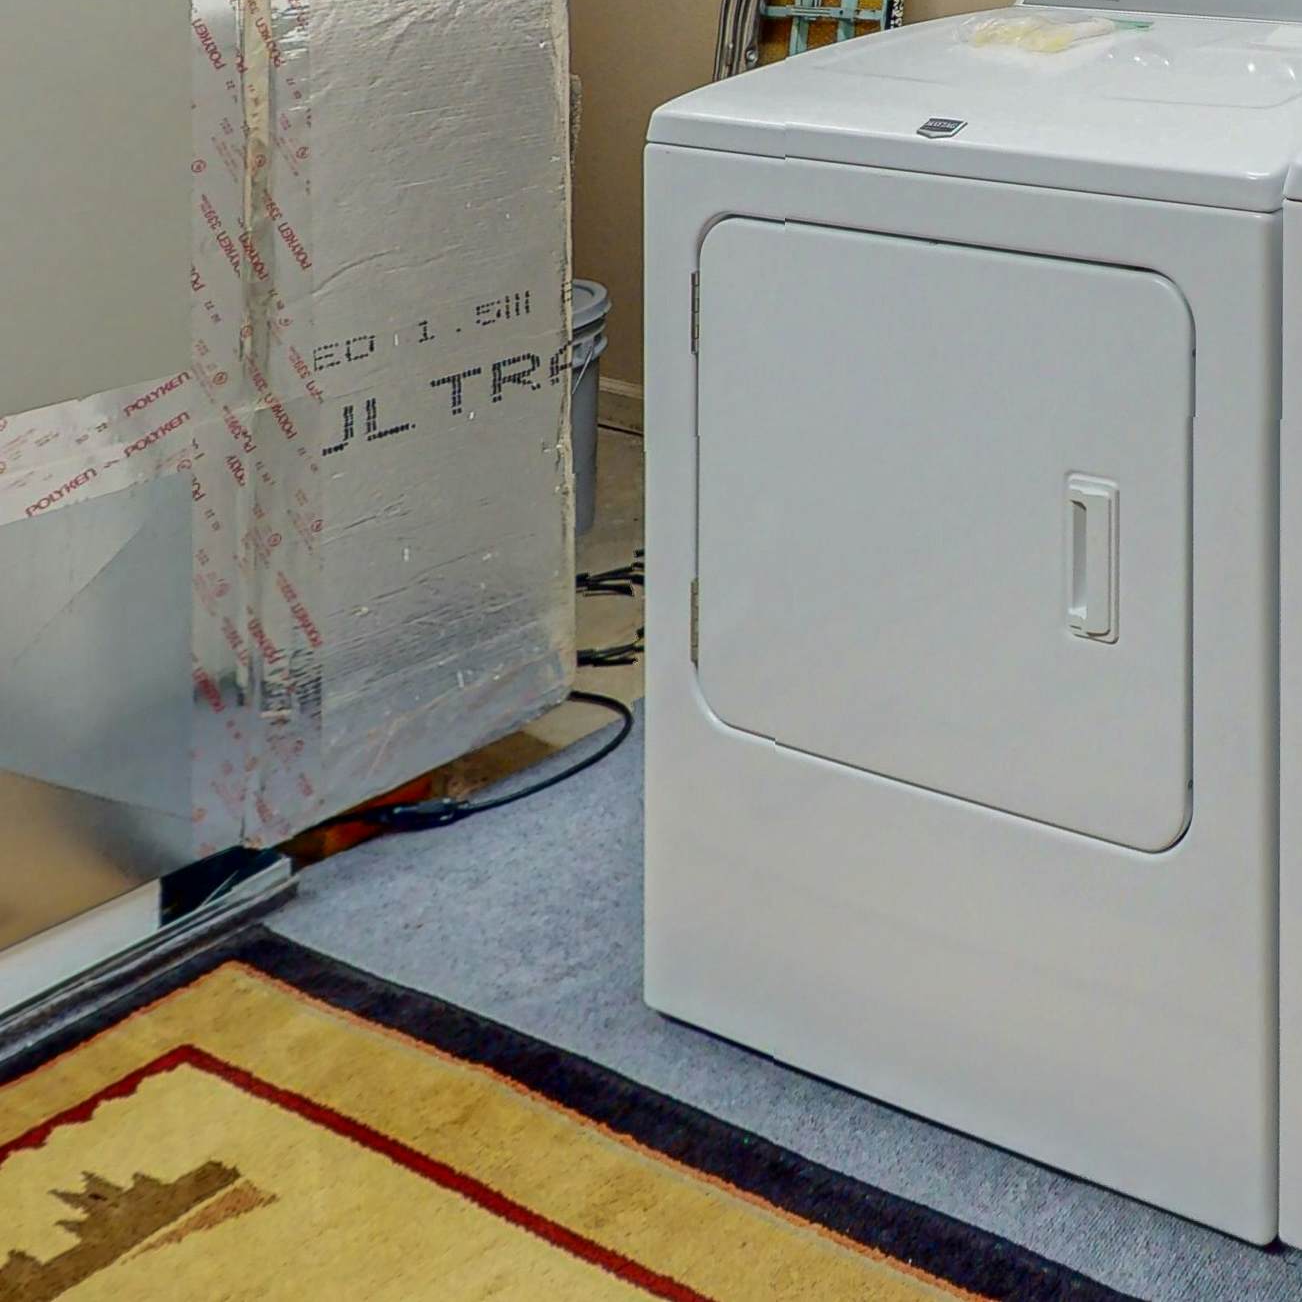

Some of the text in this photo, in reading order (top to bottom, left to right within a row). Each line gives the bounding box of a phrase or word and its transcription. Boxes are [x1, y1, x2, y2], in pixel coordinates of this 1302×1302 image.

[192, 18, 227, 71] POLYKEN
[278, 221, 313, 271] POLYKEN
[123, 371, 192, 418] POLYKEN
[123, 411, 192, 458] POLYKEN
[25, 467, 98, 518] POLYKEN
